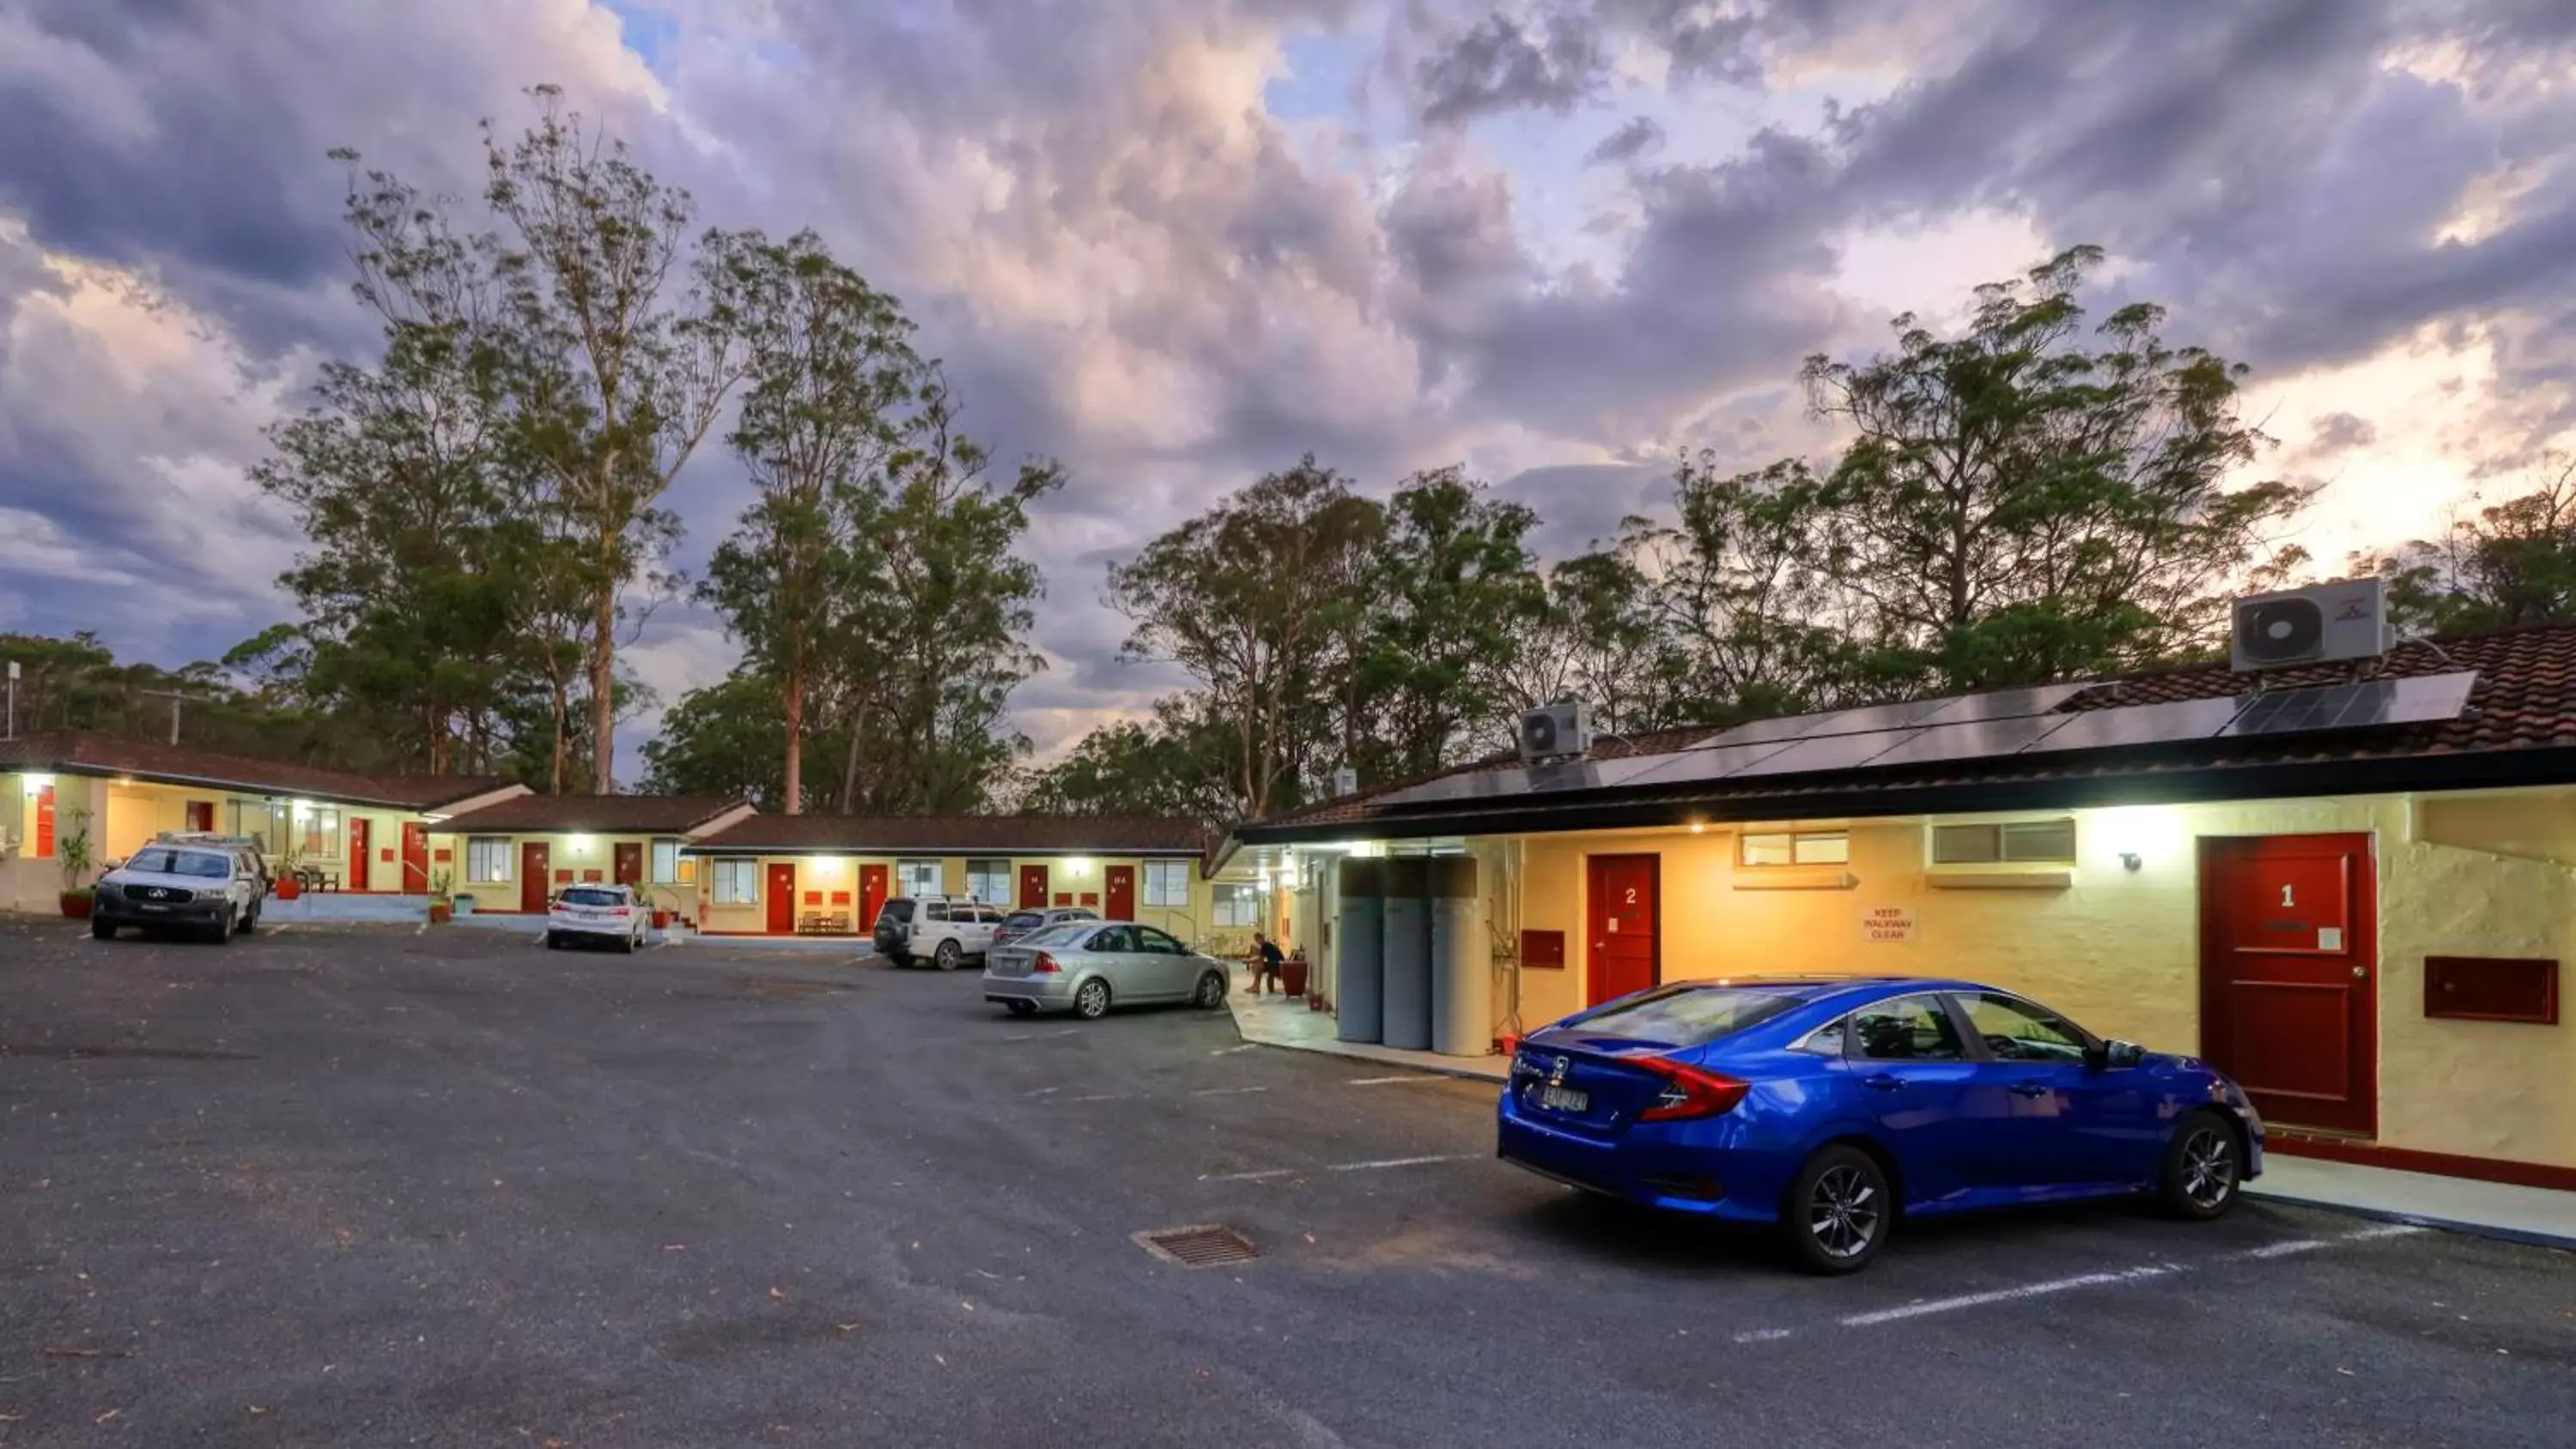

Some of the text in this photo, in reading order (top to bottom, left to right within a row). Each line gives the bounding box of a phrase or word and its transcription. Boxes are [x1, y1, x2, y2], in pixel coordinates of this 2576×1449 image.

[1625, 888, 1636, 904] 2
[2281, 884, 2294, 907] 1
[1874, 908, 1902, 918] KEEP
[1864, 919, 1911, 929] WALKWAY
[1871, 930, 1904, 939] CLEAR
